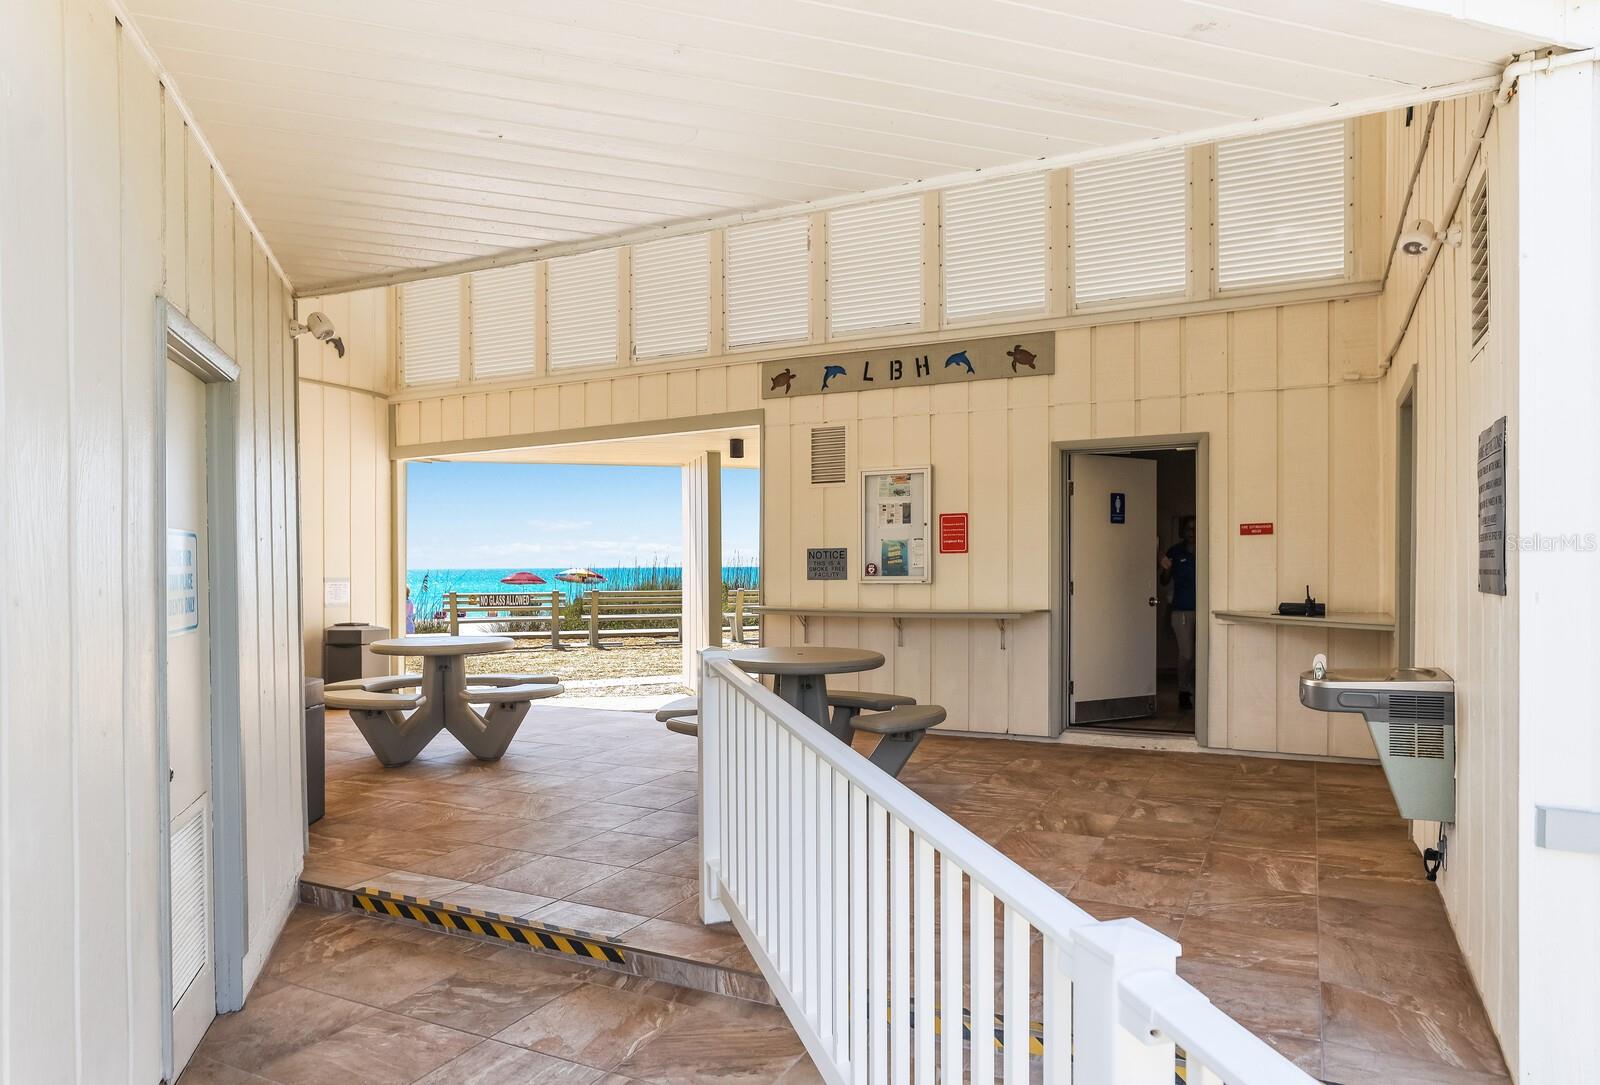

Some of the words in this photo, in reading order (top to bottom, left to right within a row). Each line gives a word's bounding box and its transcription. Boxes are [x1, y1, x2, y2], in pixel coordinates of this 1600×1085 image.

[808, 550, 846, 560] NOTICE
[480, 595, 488, 606] NO
[488, 595, 506, 606] GLASS
[506, 594, 530, 606] ALLOWED
